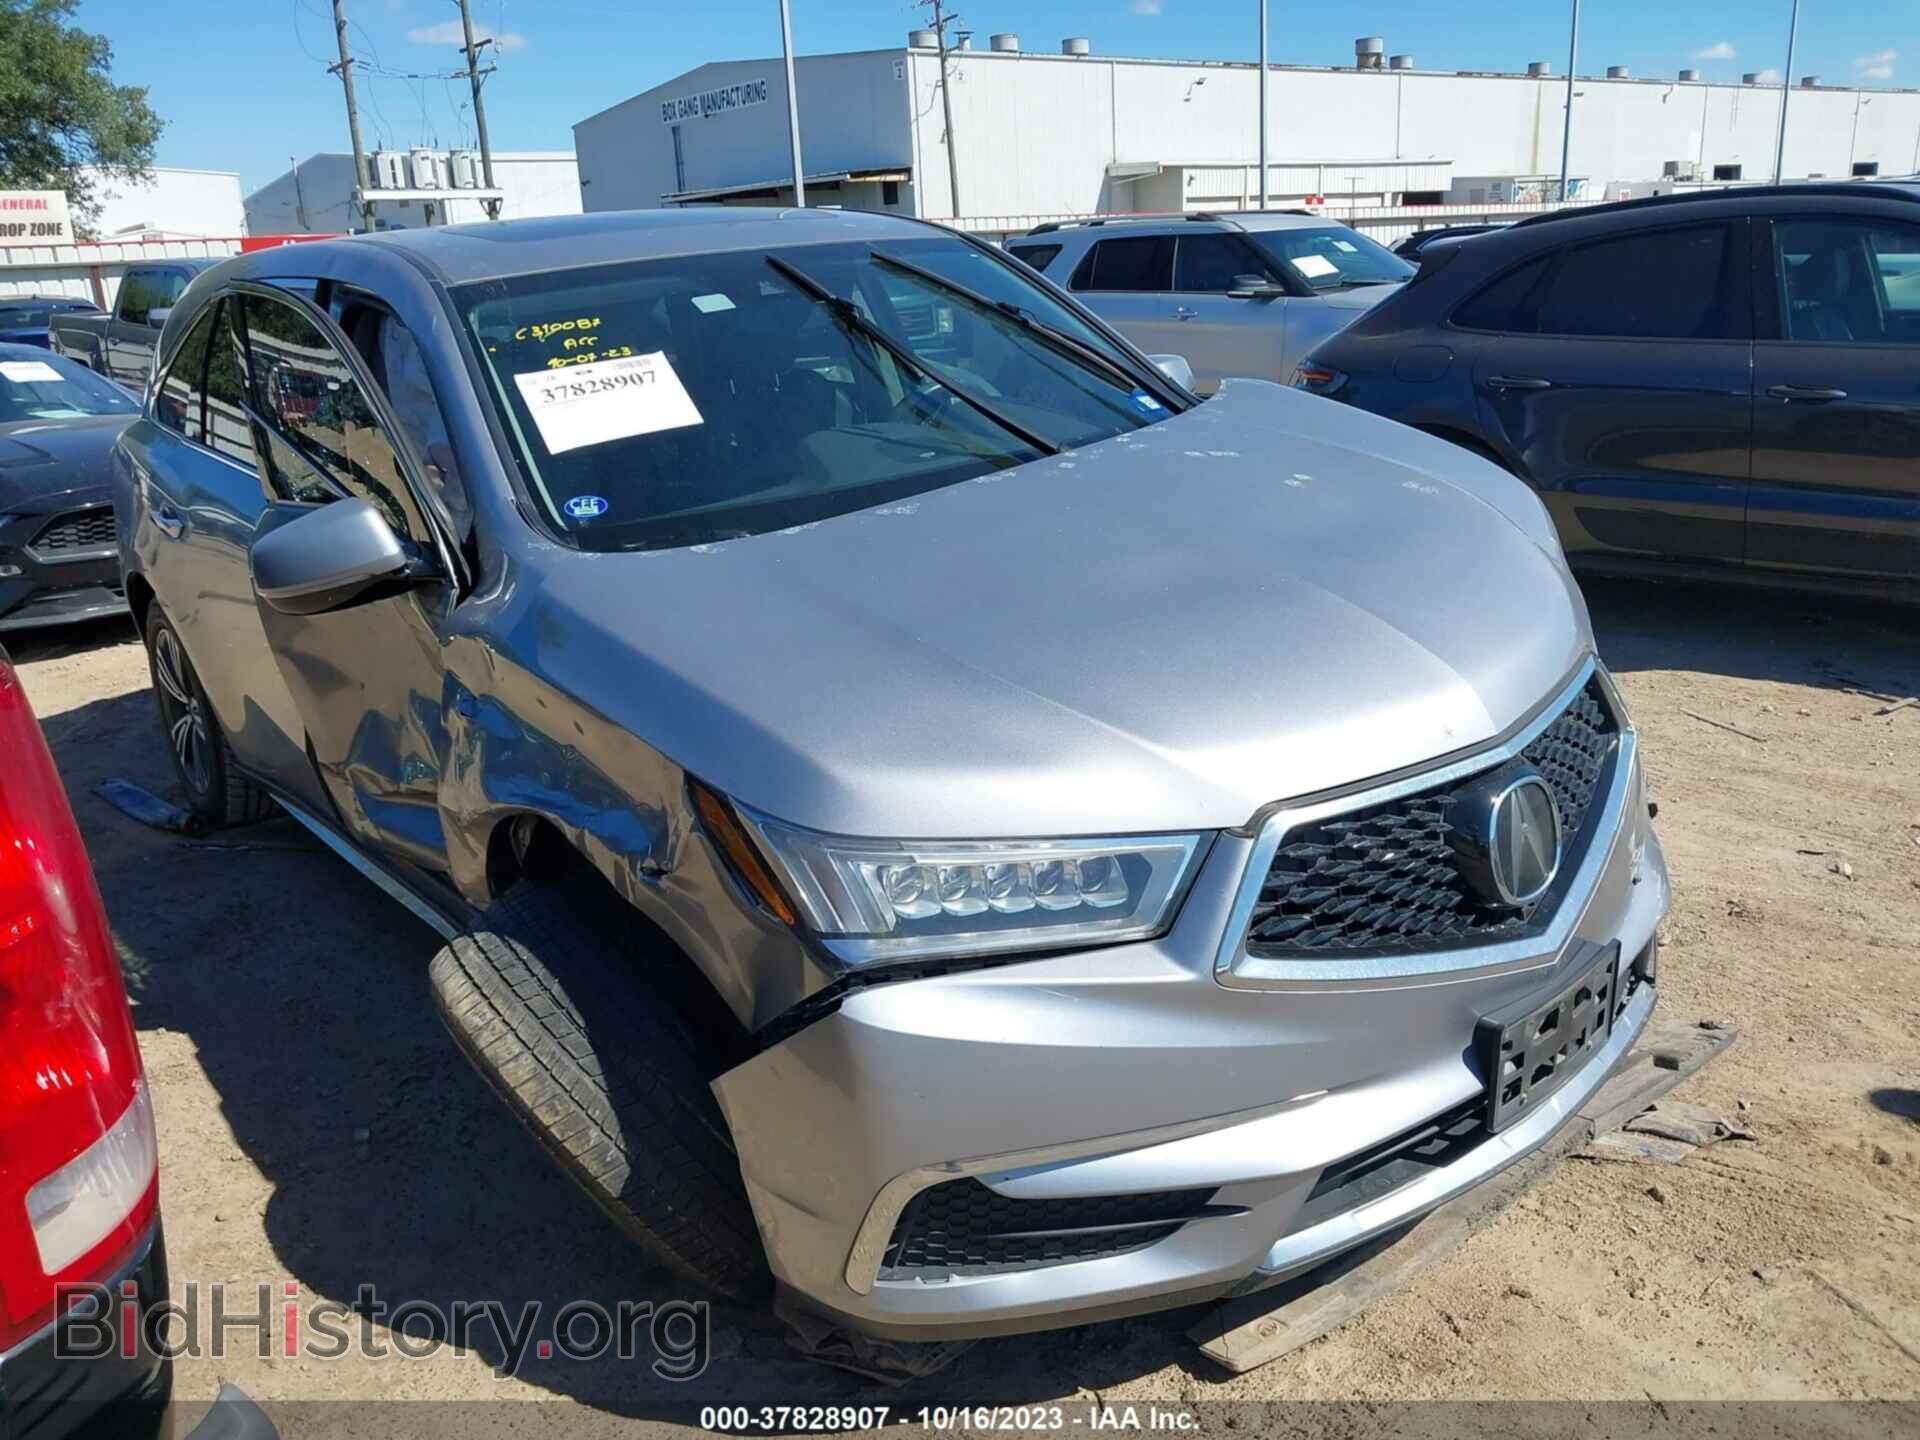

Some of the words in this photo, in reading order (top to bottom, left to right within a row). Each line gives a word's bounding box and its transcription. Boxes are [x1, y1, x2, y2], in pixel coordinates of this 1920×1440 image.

[662, 102, 678, 122] BOX
[678, 95, 699, 119] GANG
[699, 80, 767, 114] MANUFACTURING
[0, 198, 48, 210] ENERAL
[30, 222, 64, 237] ZONE
[541, 370, 656, 404] 37828907
